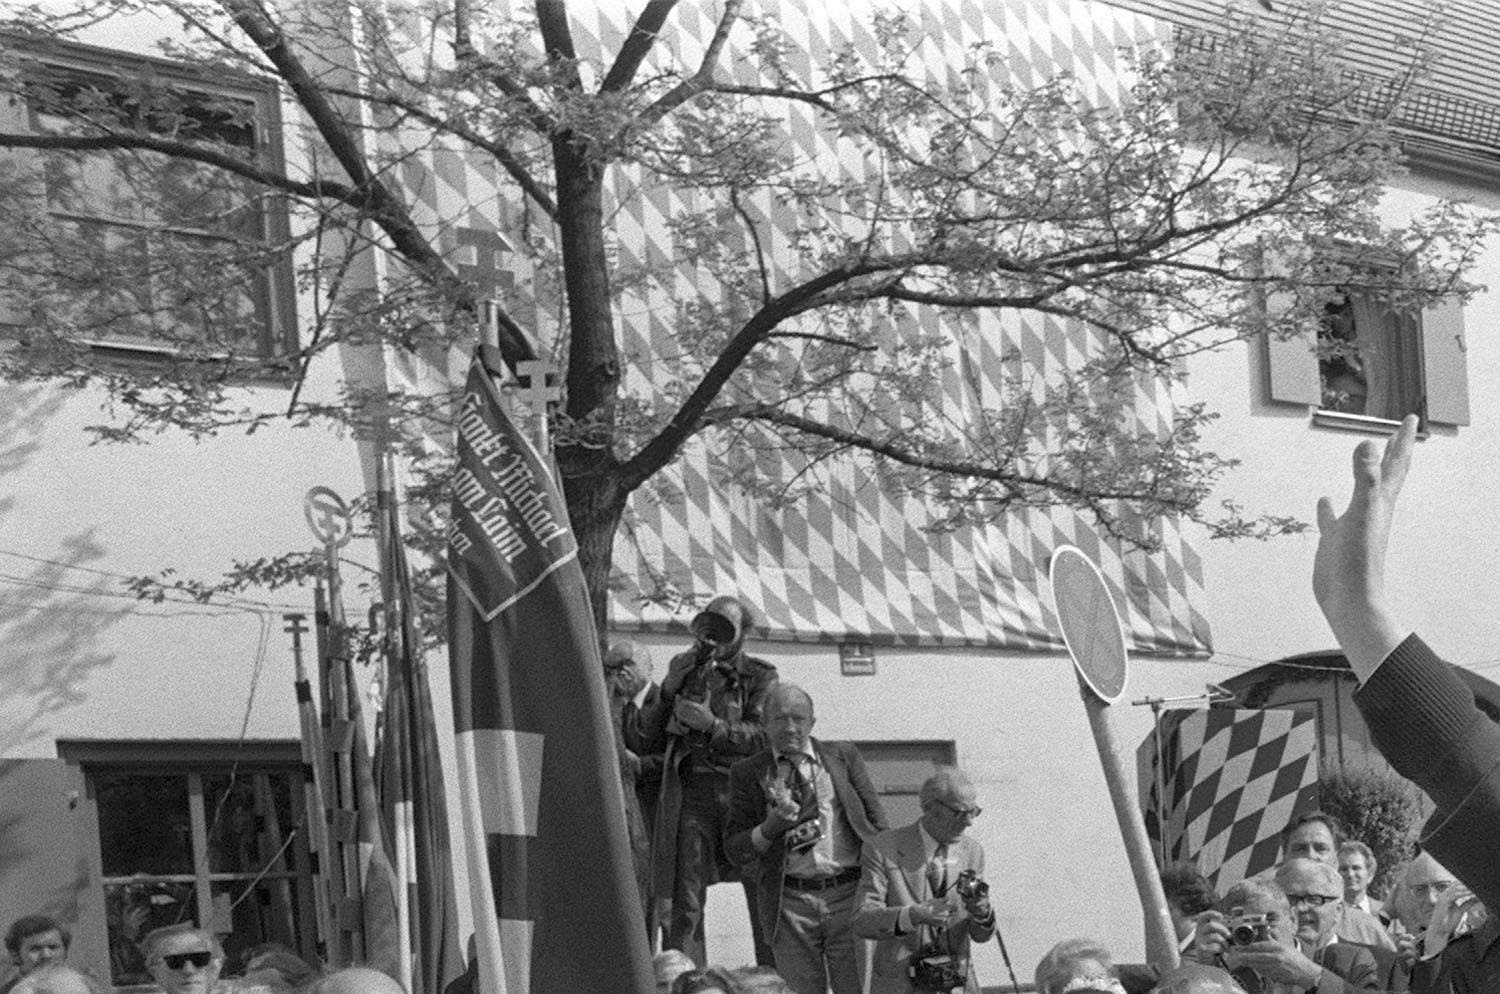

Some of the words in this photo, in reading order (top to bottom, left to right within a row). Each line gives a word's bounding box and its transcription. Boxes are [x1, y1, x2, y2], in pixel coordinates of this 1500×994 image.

[451, 468, 487, 509] am
[470, 496, 527, 563] Laim
[459, 391, 510, 467] Sankt
[490, 452, 569, 548] Michael
